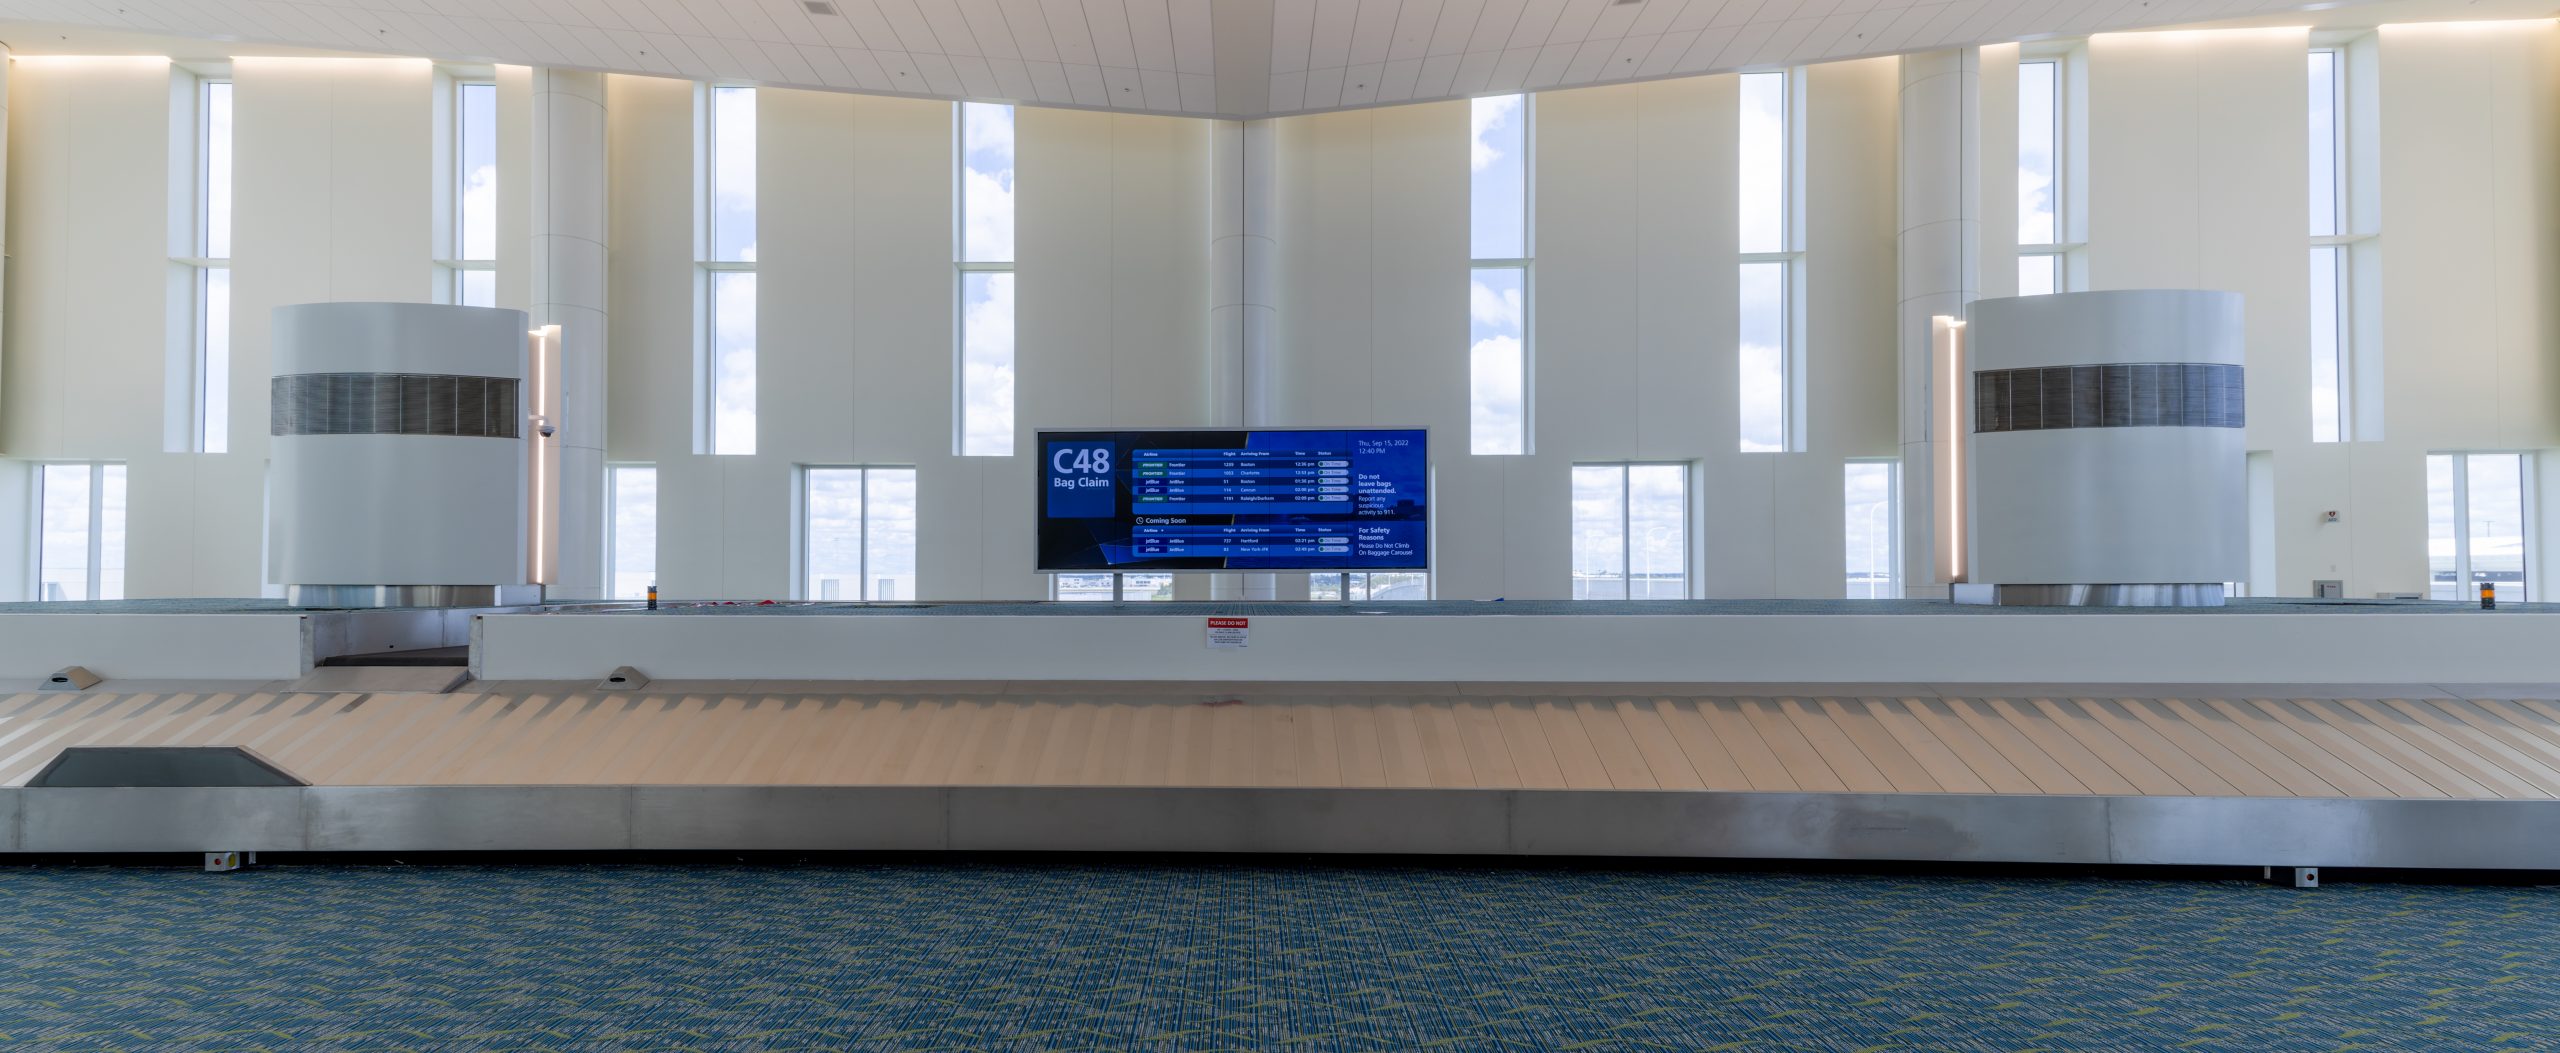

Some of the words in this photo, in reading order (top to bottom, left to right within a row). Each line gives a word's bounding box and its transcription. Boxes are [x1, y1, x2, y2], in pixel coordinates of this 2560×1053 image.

[1053, 448, 1110, 474] C48
[1054, 477, 1075, 490] Bag
[1078, 476, 1109, 487] Claim
